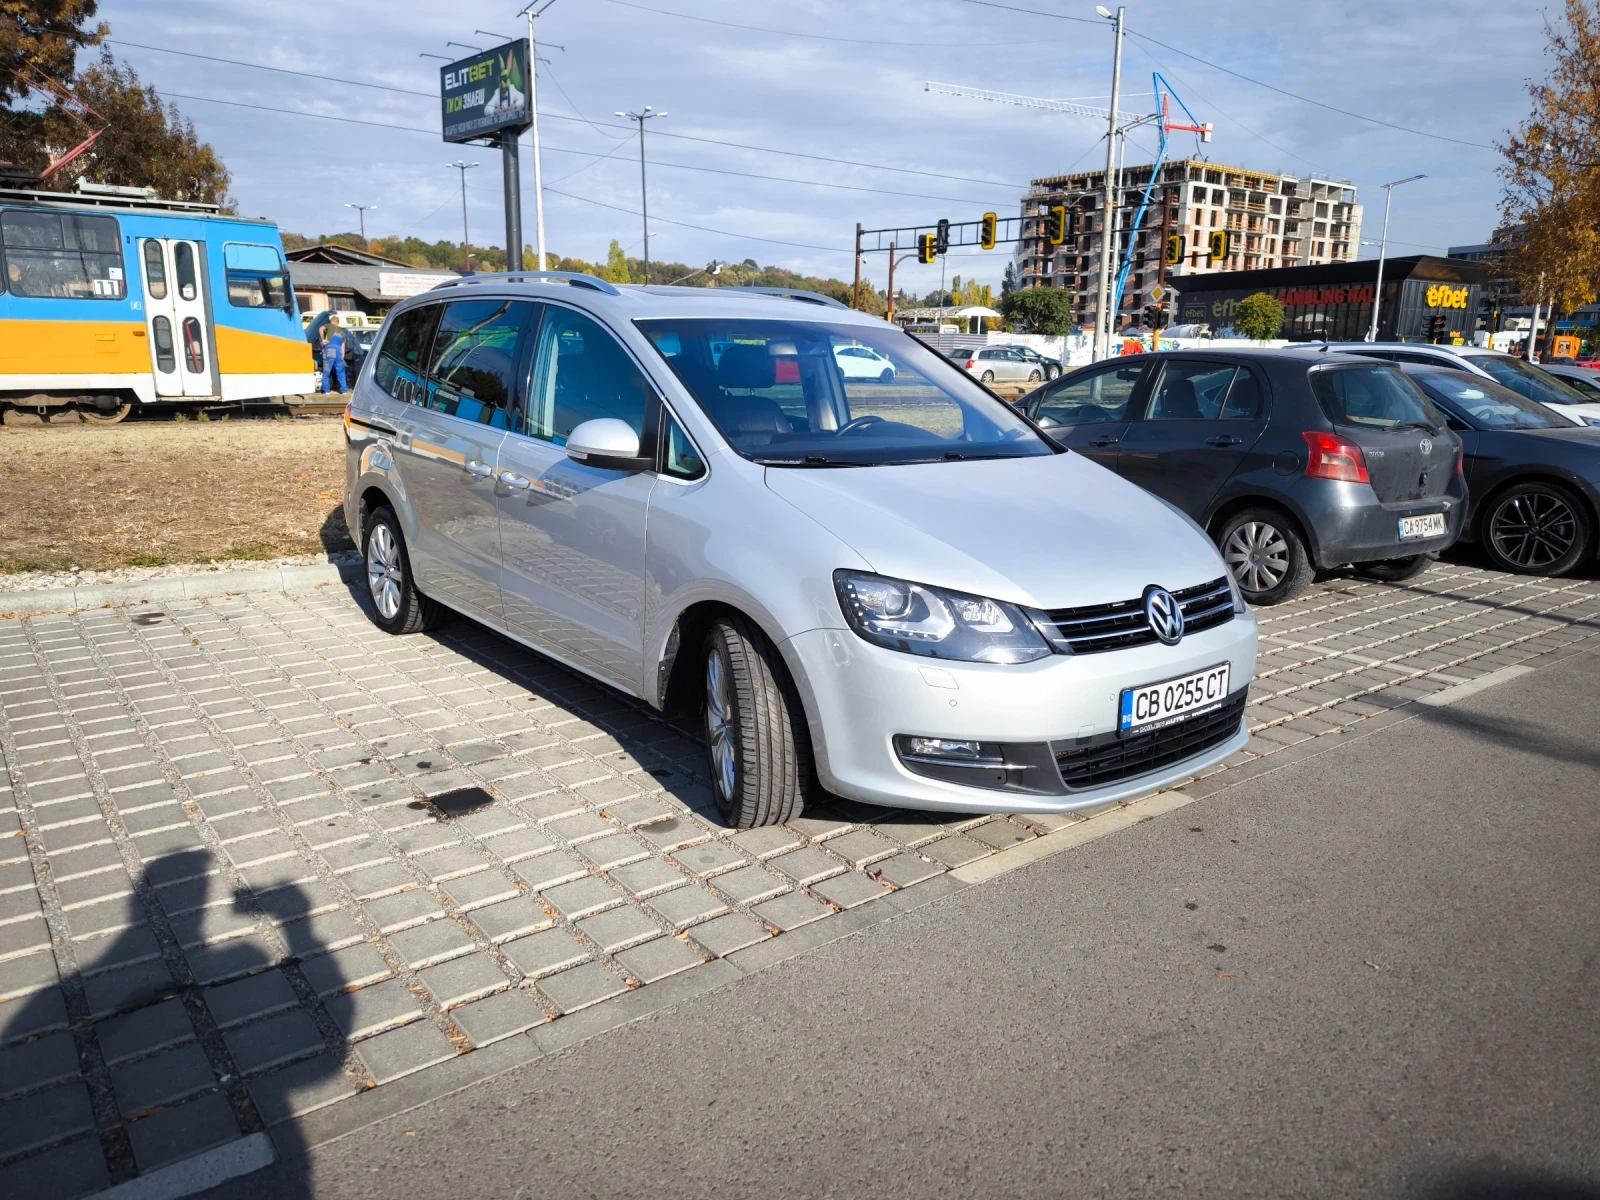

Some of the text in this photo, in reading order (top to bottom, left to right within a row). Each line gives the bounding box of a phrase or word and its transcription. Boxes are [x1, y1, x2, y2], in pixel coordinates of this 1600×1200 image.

[445, 59, 494, 90] ELITBET
[97, 281, 115, 294] 11
[1426, 284, 1468, 308] efbet
[1277, 288, 1345, 305] GAMBLING
[1185, 308, 1204, 317] efbet
[1404, 515, 1443, 534] CA 9754 MK
[1135, 689, 1160, 720] CB
[1164, 676, 1204, 713] 0255
[1206, 669, 1227, 699] CT
[1122, 714, 1132, 724] BG
[1165, 715, 1185, 726] AUTO
